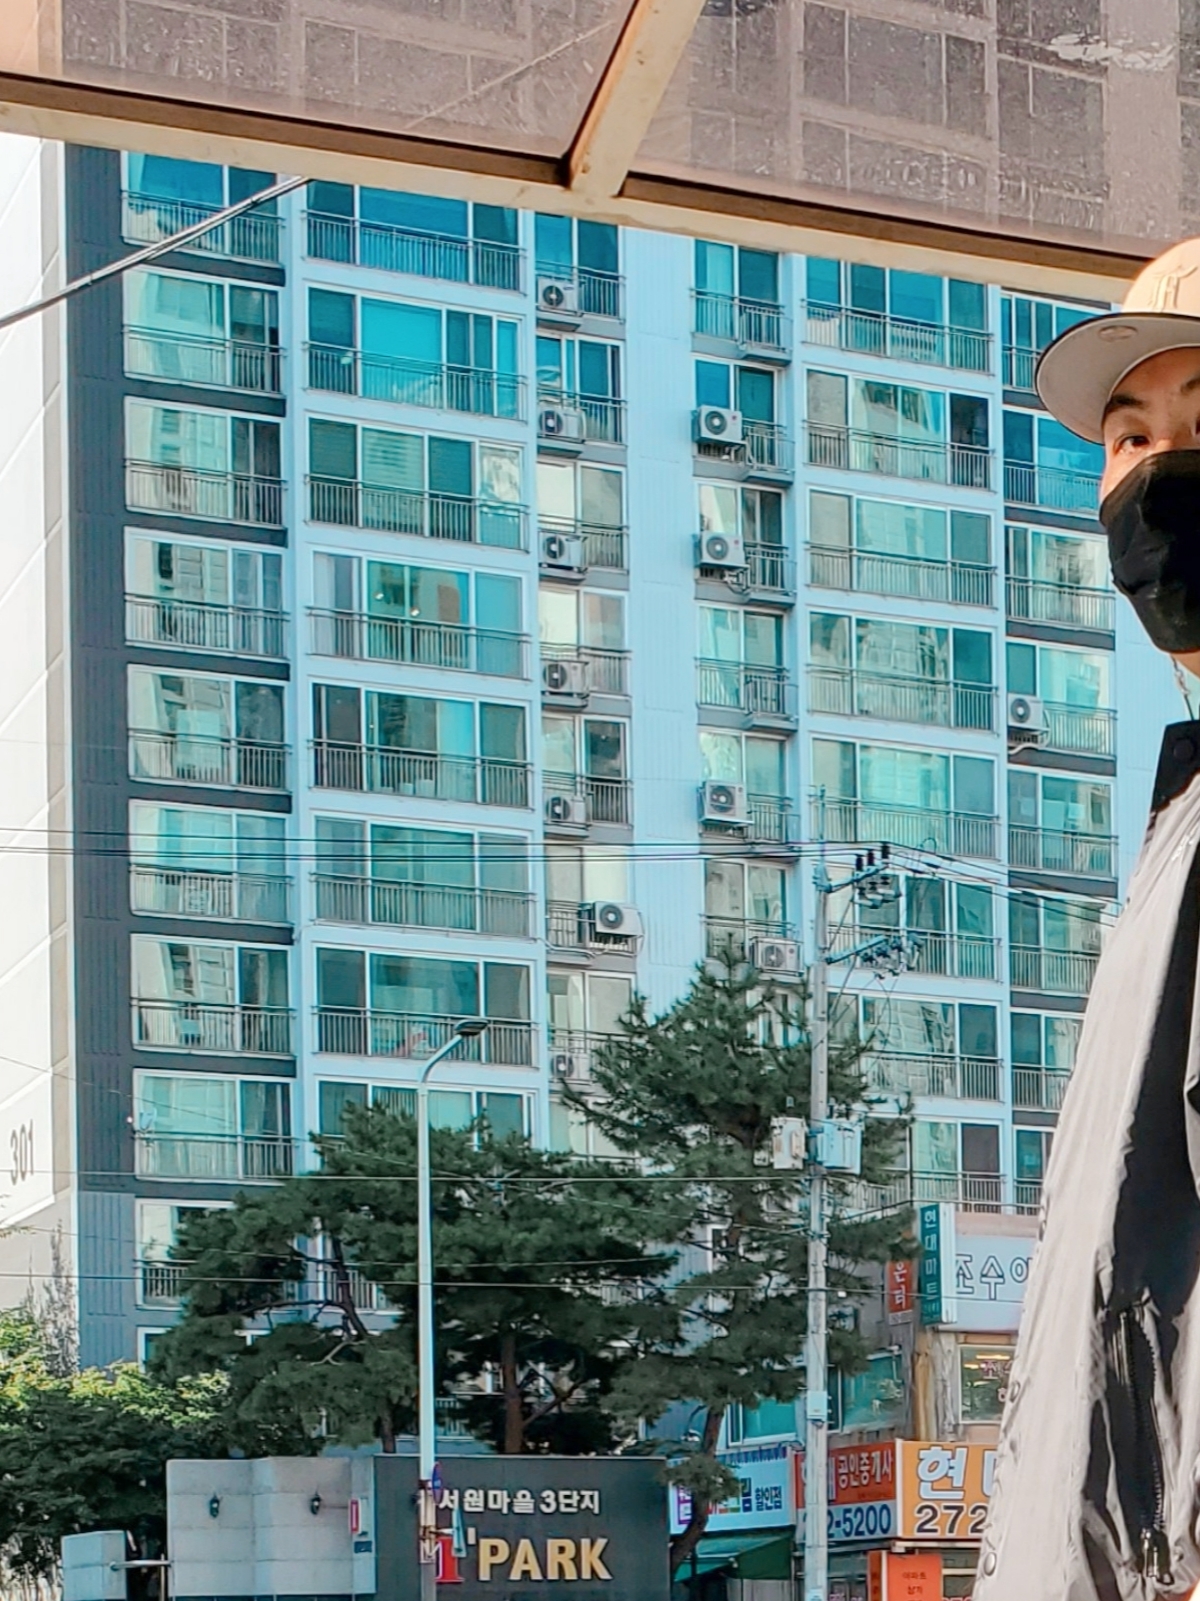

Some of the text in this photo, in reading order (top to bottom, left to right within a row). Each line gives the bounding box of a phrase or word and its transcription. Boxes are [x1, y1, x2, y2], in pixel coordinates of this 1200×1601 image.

[10, 1118, 34, 1186] 301
[838, 1448, 894, 1490] 공인중개사
[755, 1485, 783, 1512] 할인점
[803, 1503, 892, 1542] 2-5200
